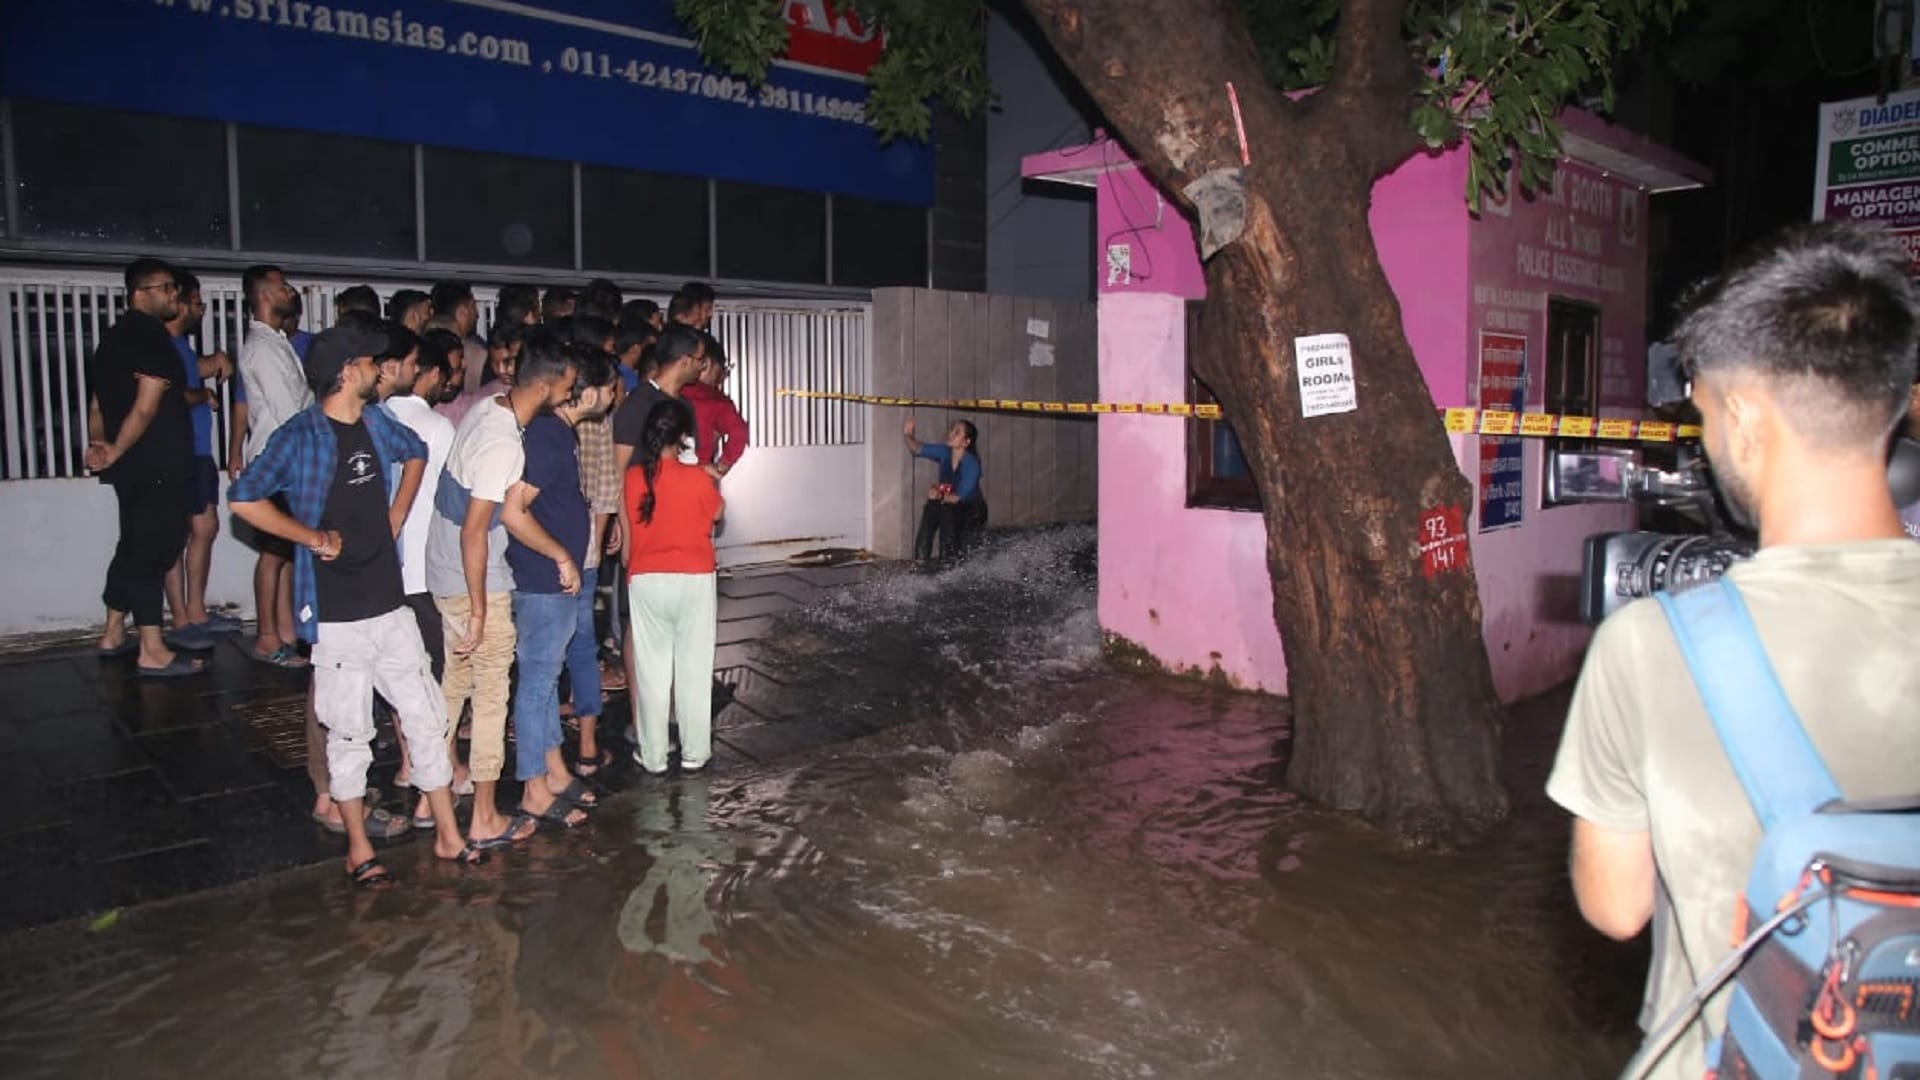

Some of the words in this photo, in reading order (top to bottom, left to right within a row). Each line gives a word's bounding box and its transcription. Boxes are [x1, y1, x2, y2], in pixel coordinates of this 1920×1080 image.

[1571, 173, 1613, 219] BOOTH
[1545, 215, 1568, 249] ALL
[1516, 244, 1550, 280] POLICE
[1425, 516, 1448, 540] 93
[1432, 546, 1456, 569] 141
